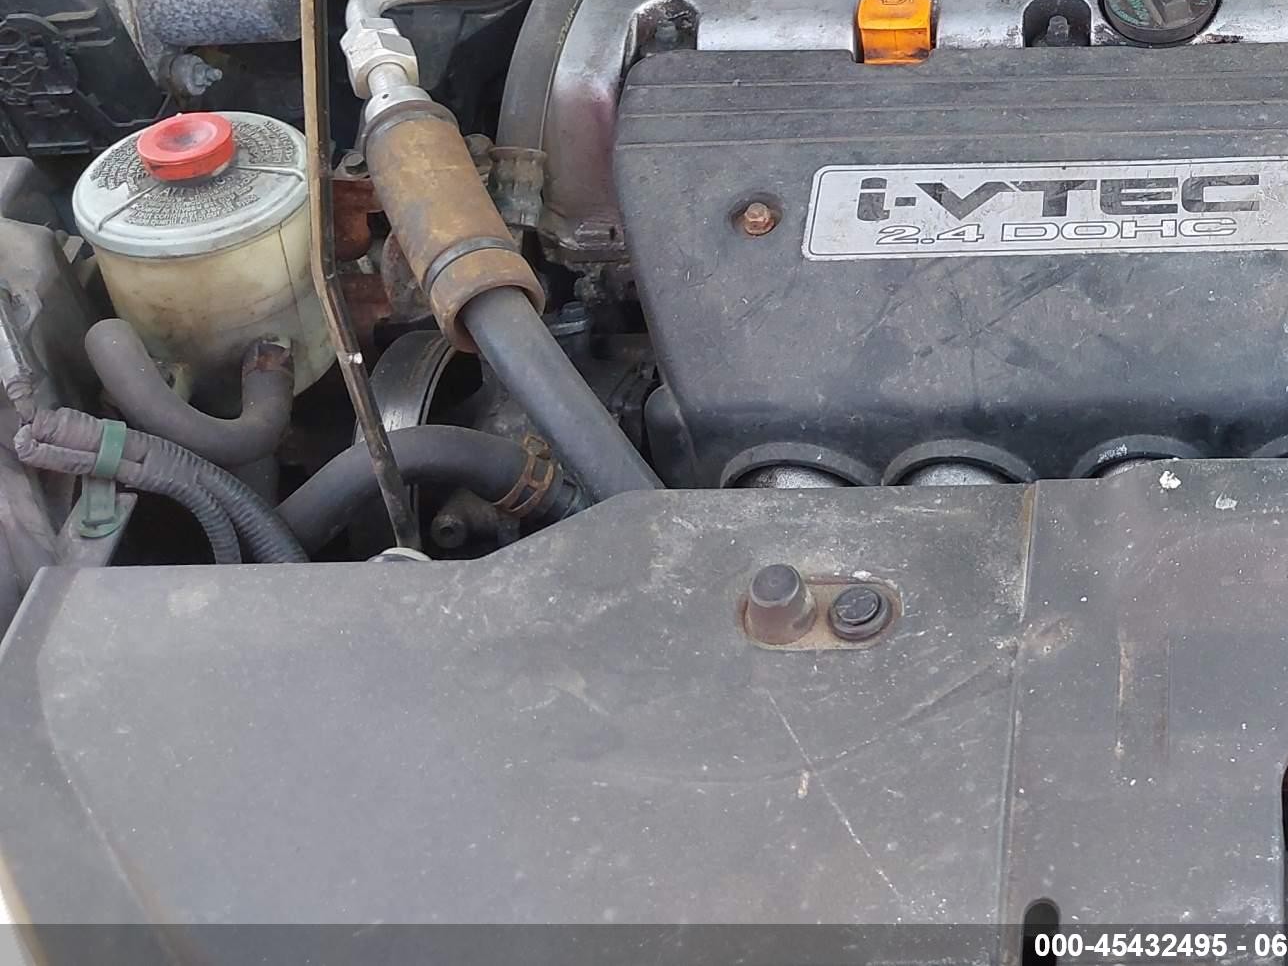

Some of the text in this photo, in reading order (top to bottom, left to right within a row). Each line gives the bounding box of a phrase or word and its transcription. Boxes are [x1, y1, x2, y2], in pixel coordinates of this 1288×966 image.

[856, 173, 1260, 222] i-VTEC
[875, 216, 1238, 244] 2.4 DOHC
